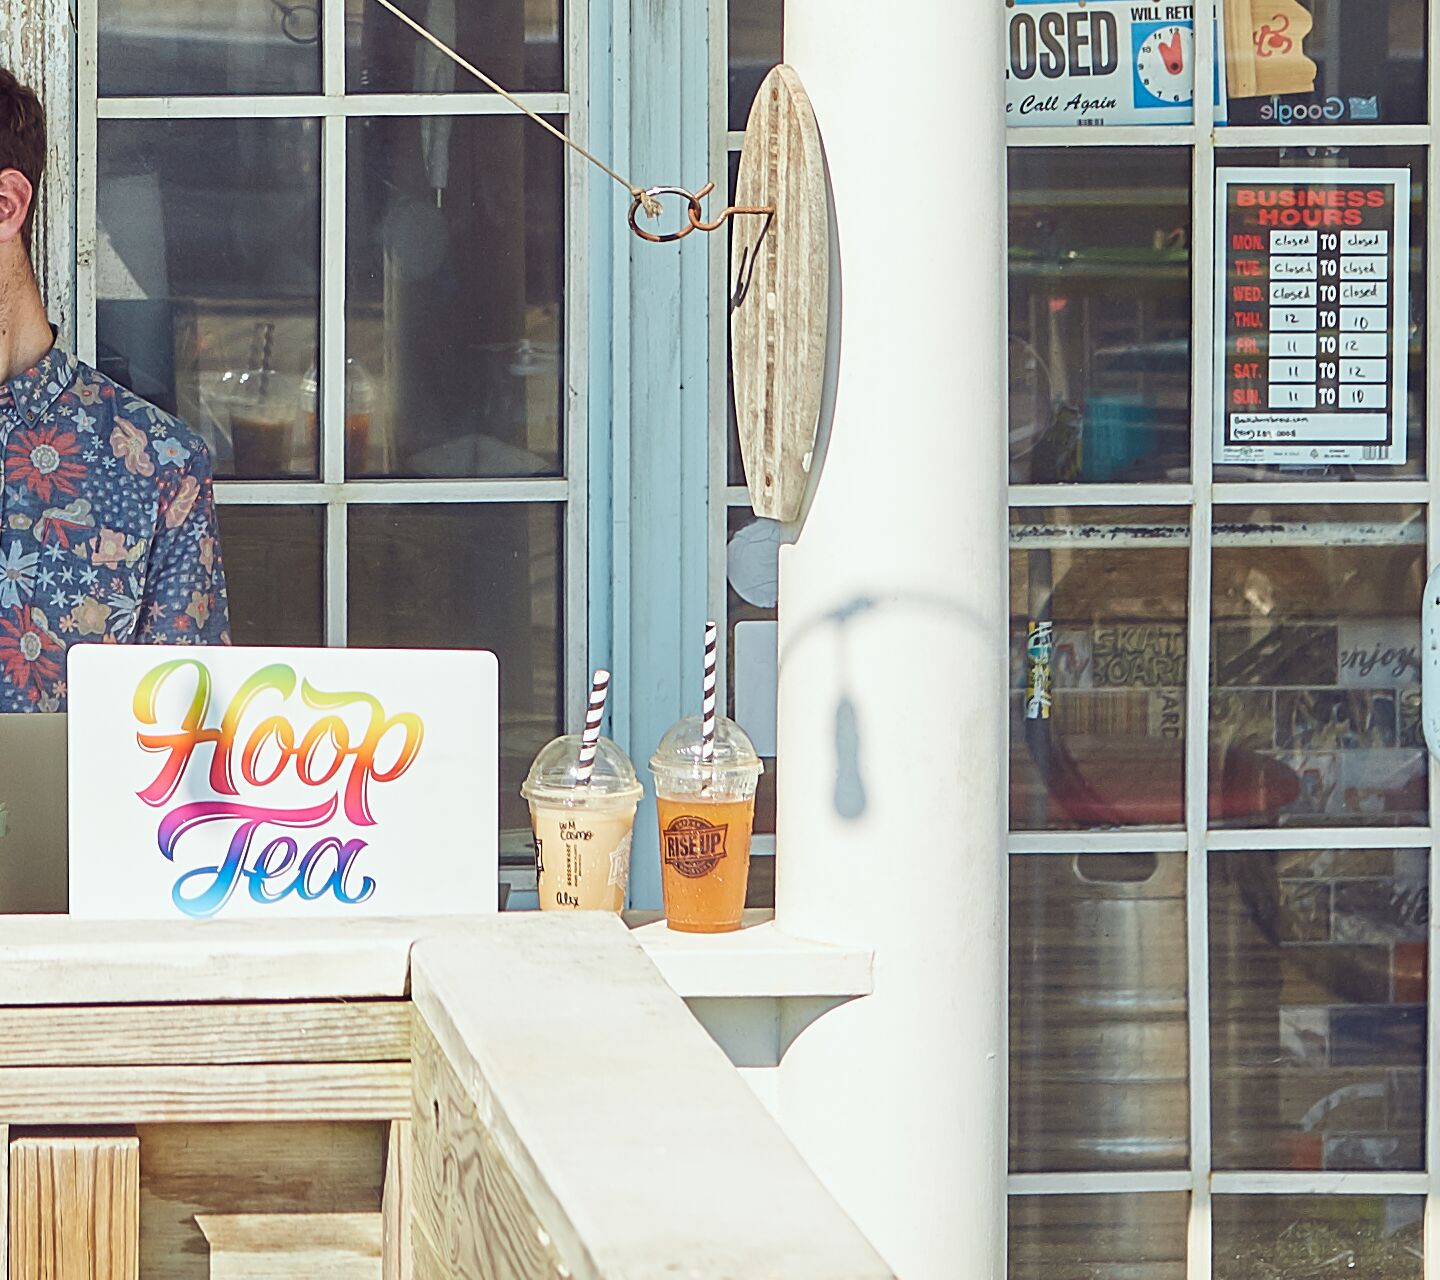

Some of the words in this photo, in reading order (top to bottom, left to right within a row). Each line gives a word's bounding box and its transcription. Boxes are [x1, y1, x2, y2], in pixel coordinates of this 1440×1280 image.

[1131, 8, 1162, 21] WILL
[1006, 11, 1119, 80] OSED
[1020, 95, 1059, 115] Call
[1063, 93, 1118, 115] Again
[1236, 189, 1385, 207] BUSINESS
[1258, 208, 1363, 225] HOURS
[1320, 234, 1337, 251] TO
[1320, 259, 1337, 277] TO
[1320, 285, 1337, 302] TO
[1285, 313, 1300, 324] 12
[1319, 311, 1337, 328] TO
[1354, 316, 1369, 330] 10
[1319, 337, 1337, 354] TO
[1345, 340, 1359, 351] 12
[1319, 362, 1336, 379] TO
[1349, 366, 1366, 378] 12
[1319, 388, 1336, 405] TO
[1352, 389, 1365, 404] 10
[132, 658, 425, 826] Hoop
[667, 835, 698, 857] RISE
[700, 832, 721, 855] UP
[157, 790, 377, 919] Tea
